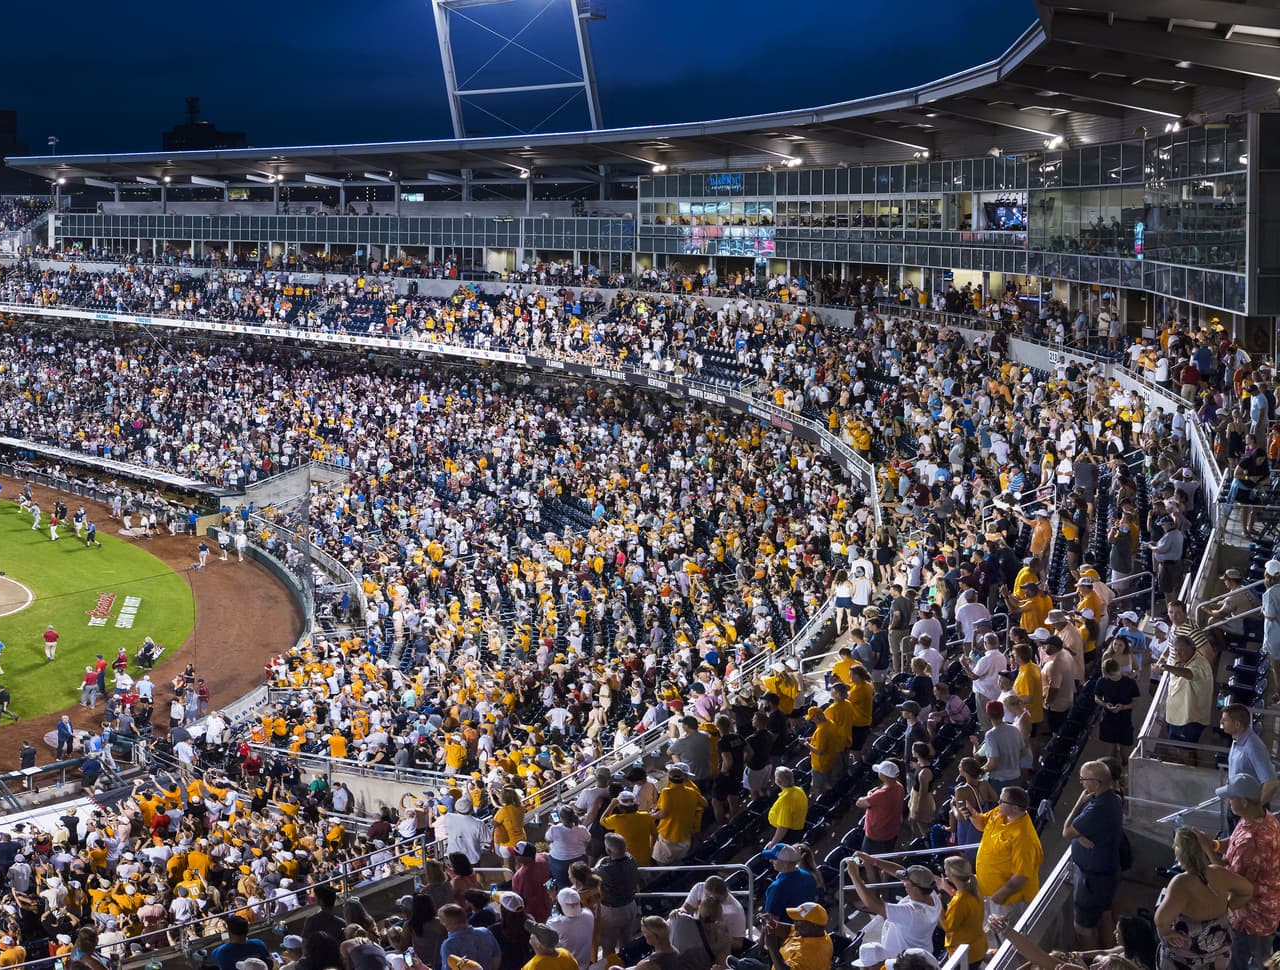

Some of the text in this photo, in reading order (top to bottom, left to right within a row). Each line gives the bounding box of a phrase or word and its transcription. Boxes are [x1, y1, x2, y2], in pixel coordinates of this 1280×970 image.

[546, 359, 565, 369] FLORIDA
[591, 367, 626, 381] FLORIDA STATE
[647, 377, 668, 390] KENTUCKY
[688, 388, 726, 404] NORTH CAROLINA
